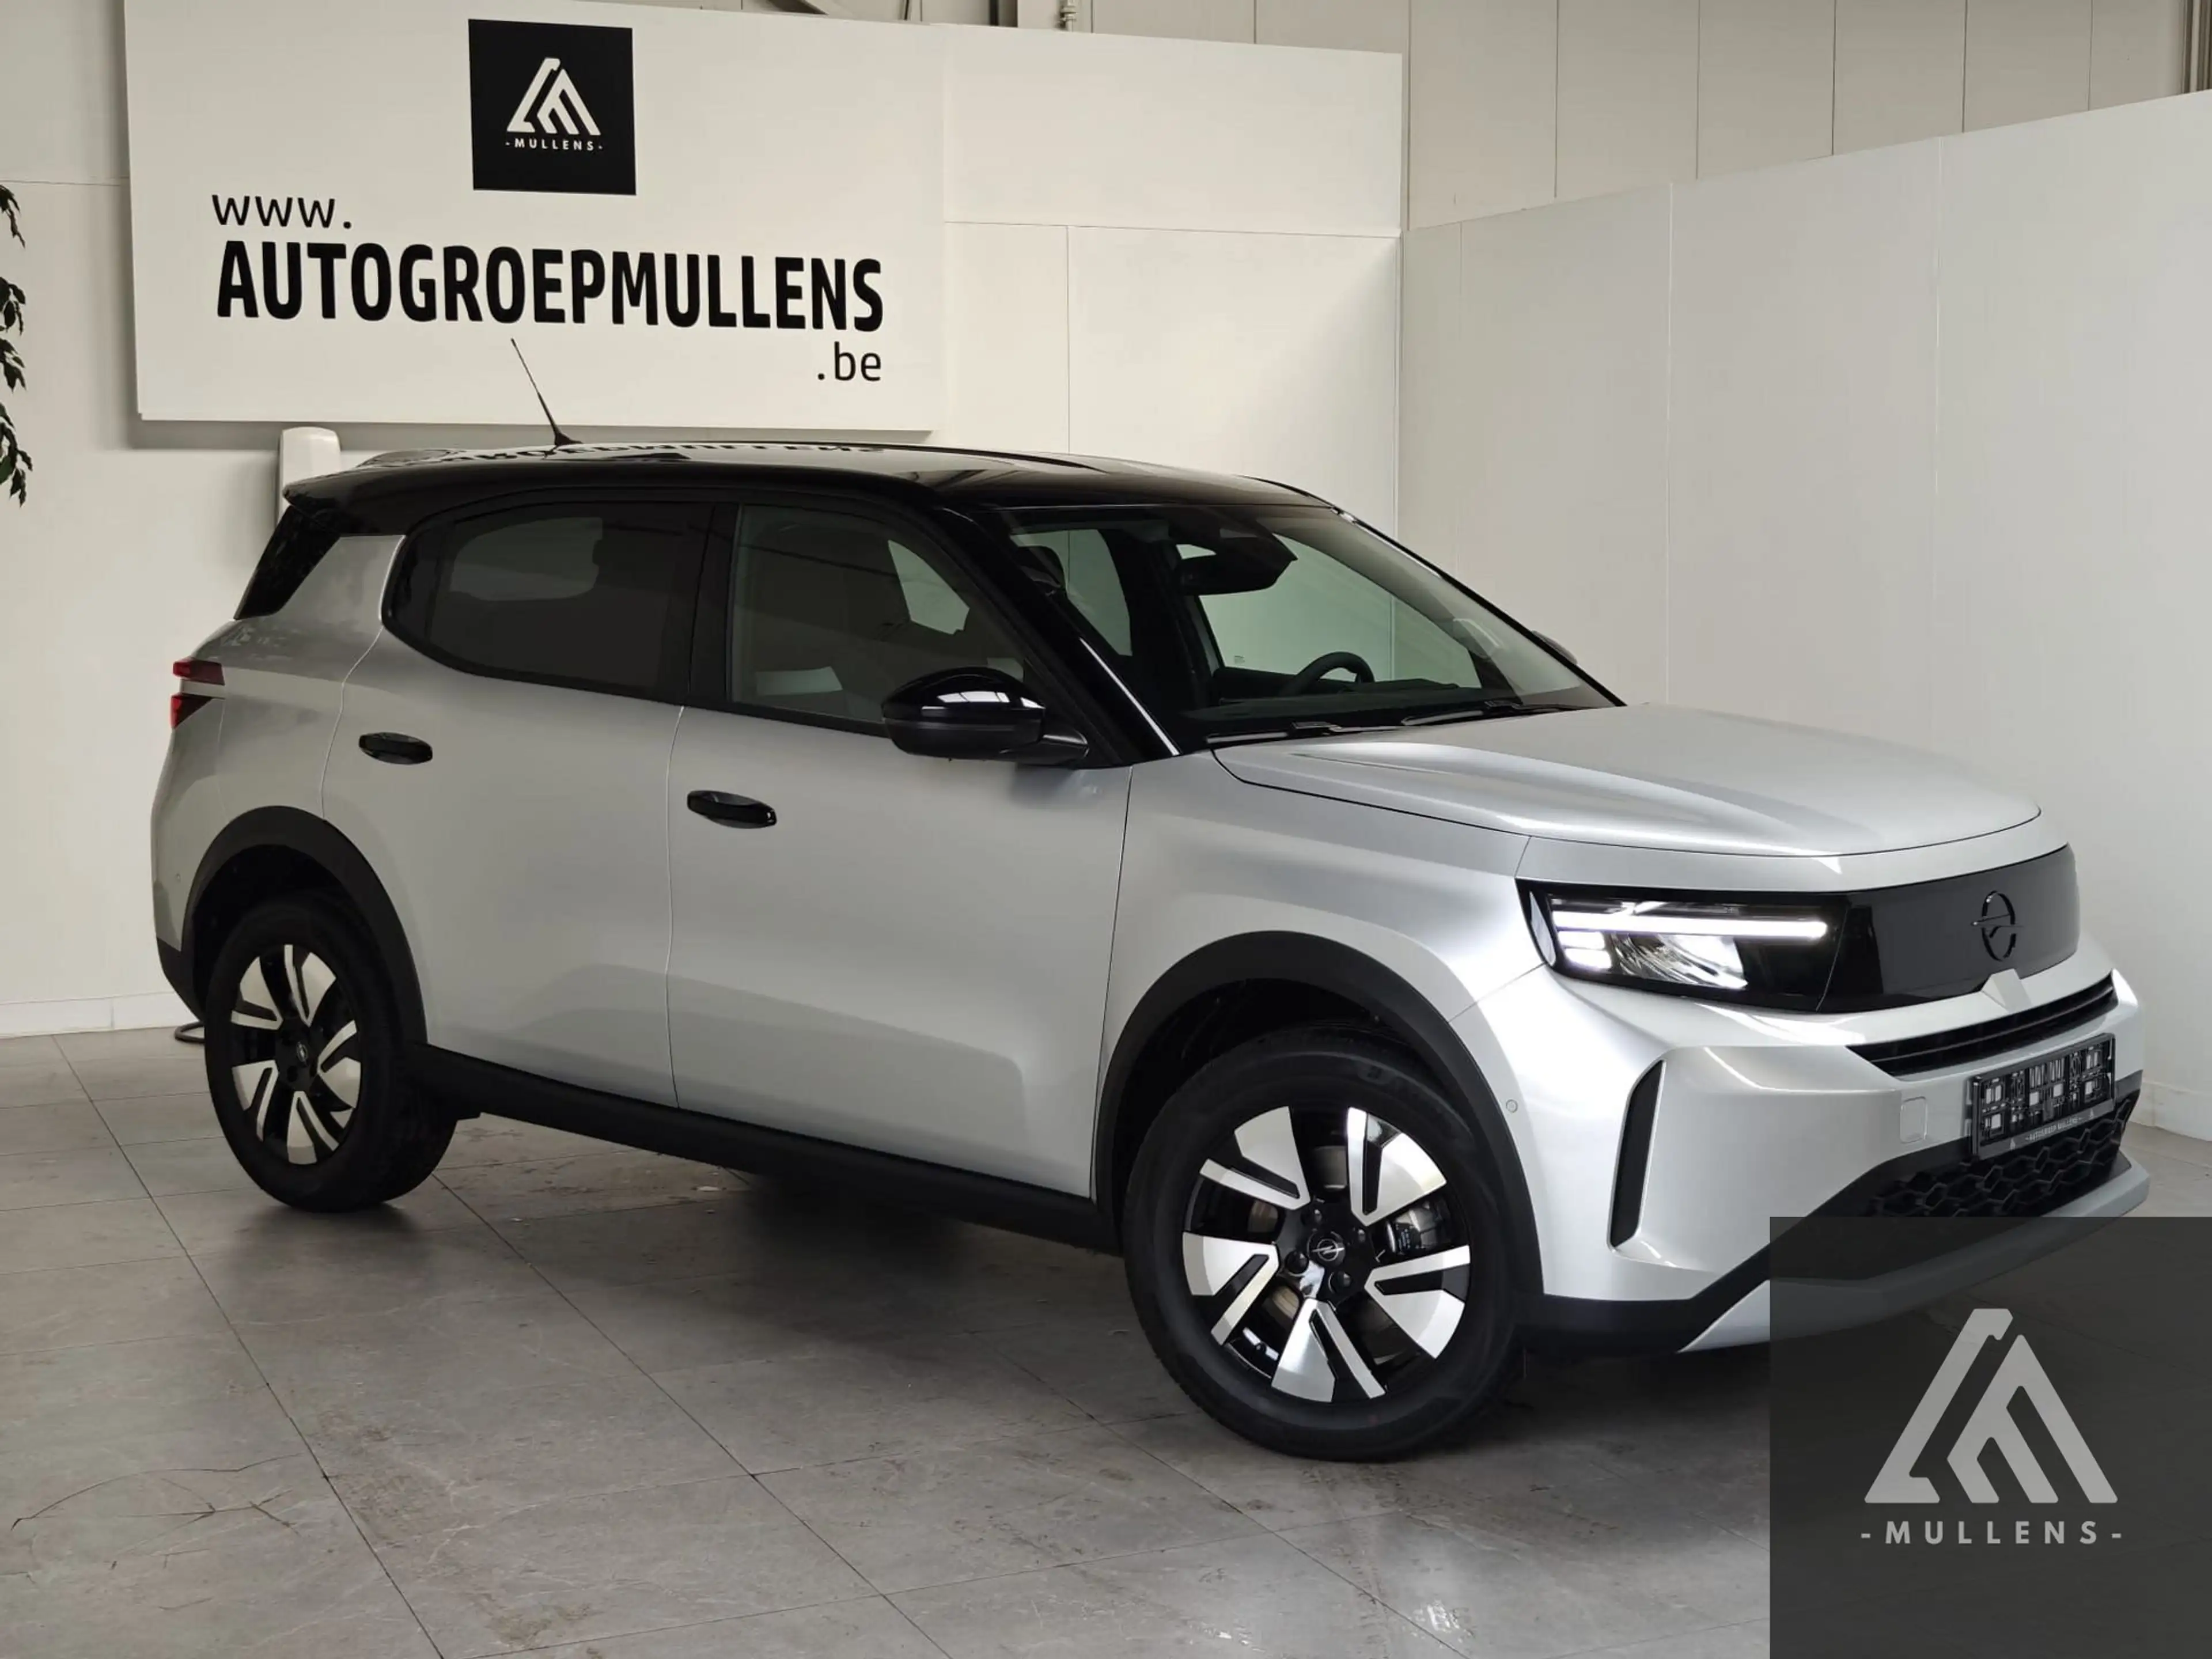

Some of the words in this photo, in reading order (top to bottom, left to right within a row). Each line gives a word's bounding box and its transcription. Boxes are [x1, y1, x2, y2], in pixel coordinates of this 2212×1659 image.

[211, 194, 352, 230] www.
[217, 240, 884, 332] AUTOGROEPMULLENS
[817, 341, 881, 382] .be
